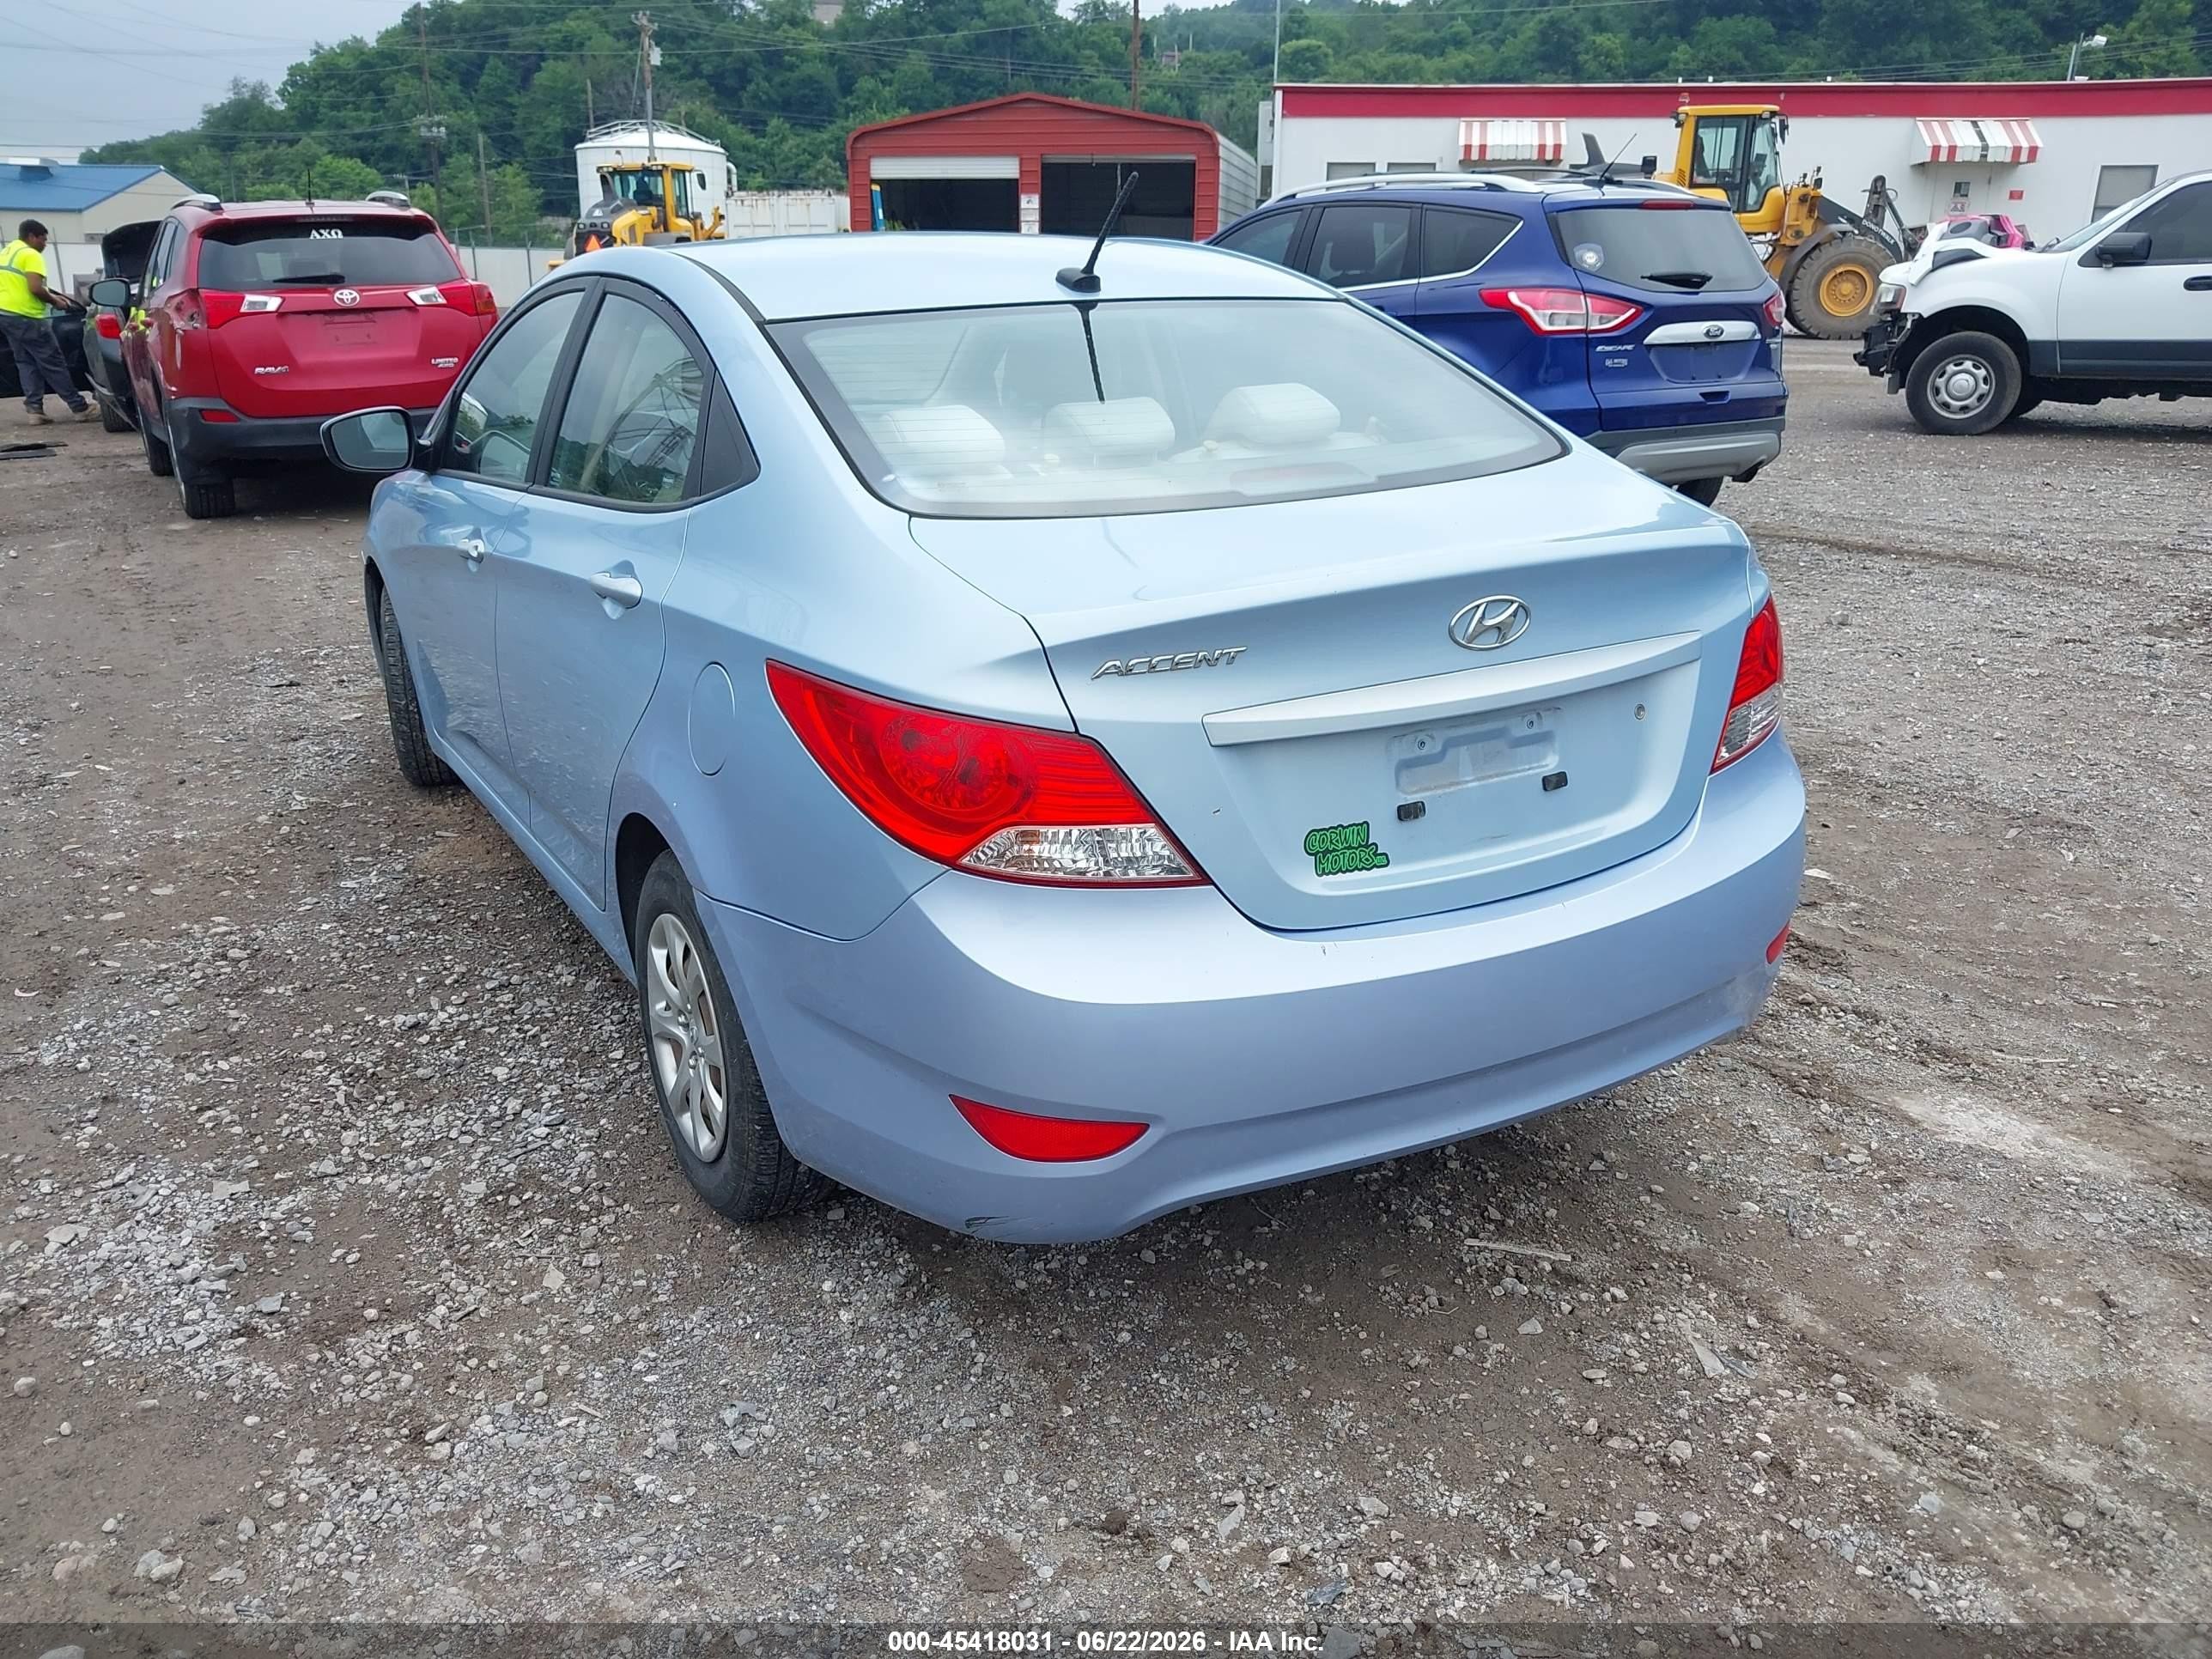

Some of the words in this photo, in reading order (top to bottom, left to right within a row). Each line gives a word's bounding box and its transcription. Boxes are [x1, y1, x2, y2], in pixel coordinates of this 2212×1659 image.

[1091, 646, 1247, 680] ACCENT
[1306, 823, 1368, 853] CORWIN
[1316, 845, 1376, 874] MOTORS
